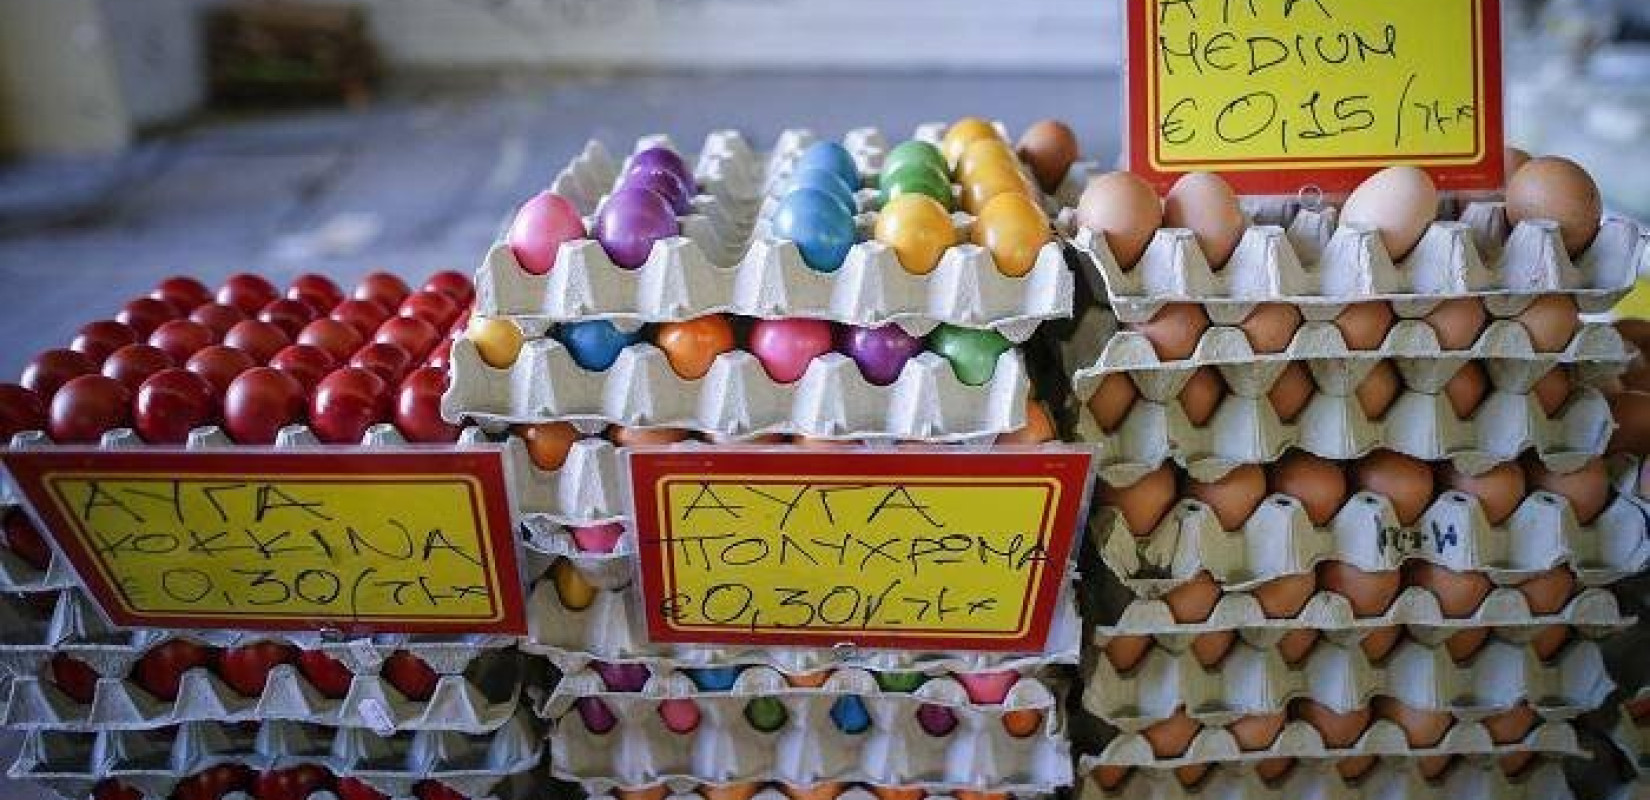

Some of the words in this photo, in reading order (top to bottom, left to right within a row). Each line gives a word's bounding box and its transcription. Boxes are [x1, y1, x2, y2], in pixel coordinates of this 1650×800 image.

[1159, 24, 1397, 76] MEDIUM
[84, 479, 334, 523] ΑΥΓΑ
[681, 482, 944, 529] ΑΥΓΑ
[94, 517, 488, 568] ΚΟΚΚΙΝΑ
